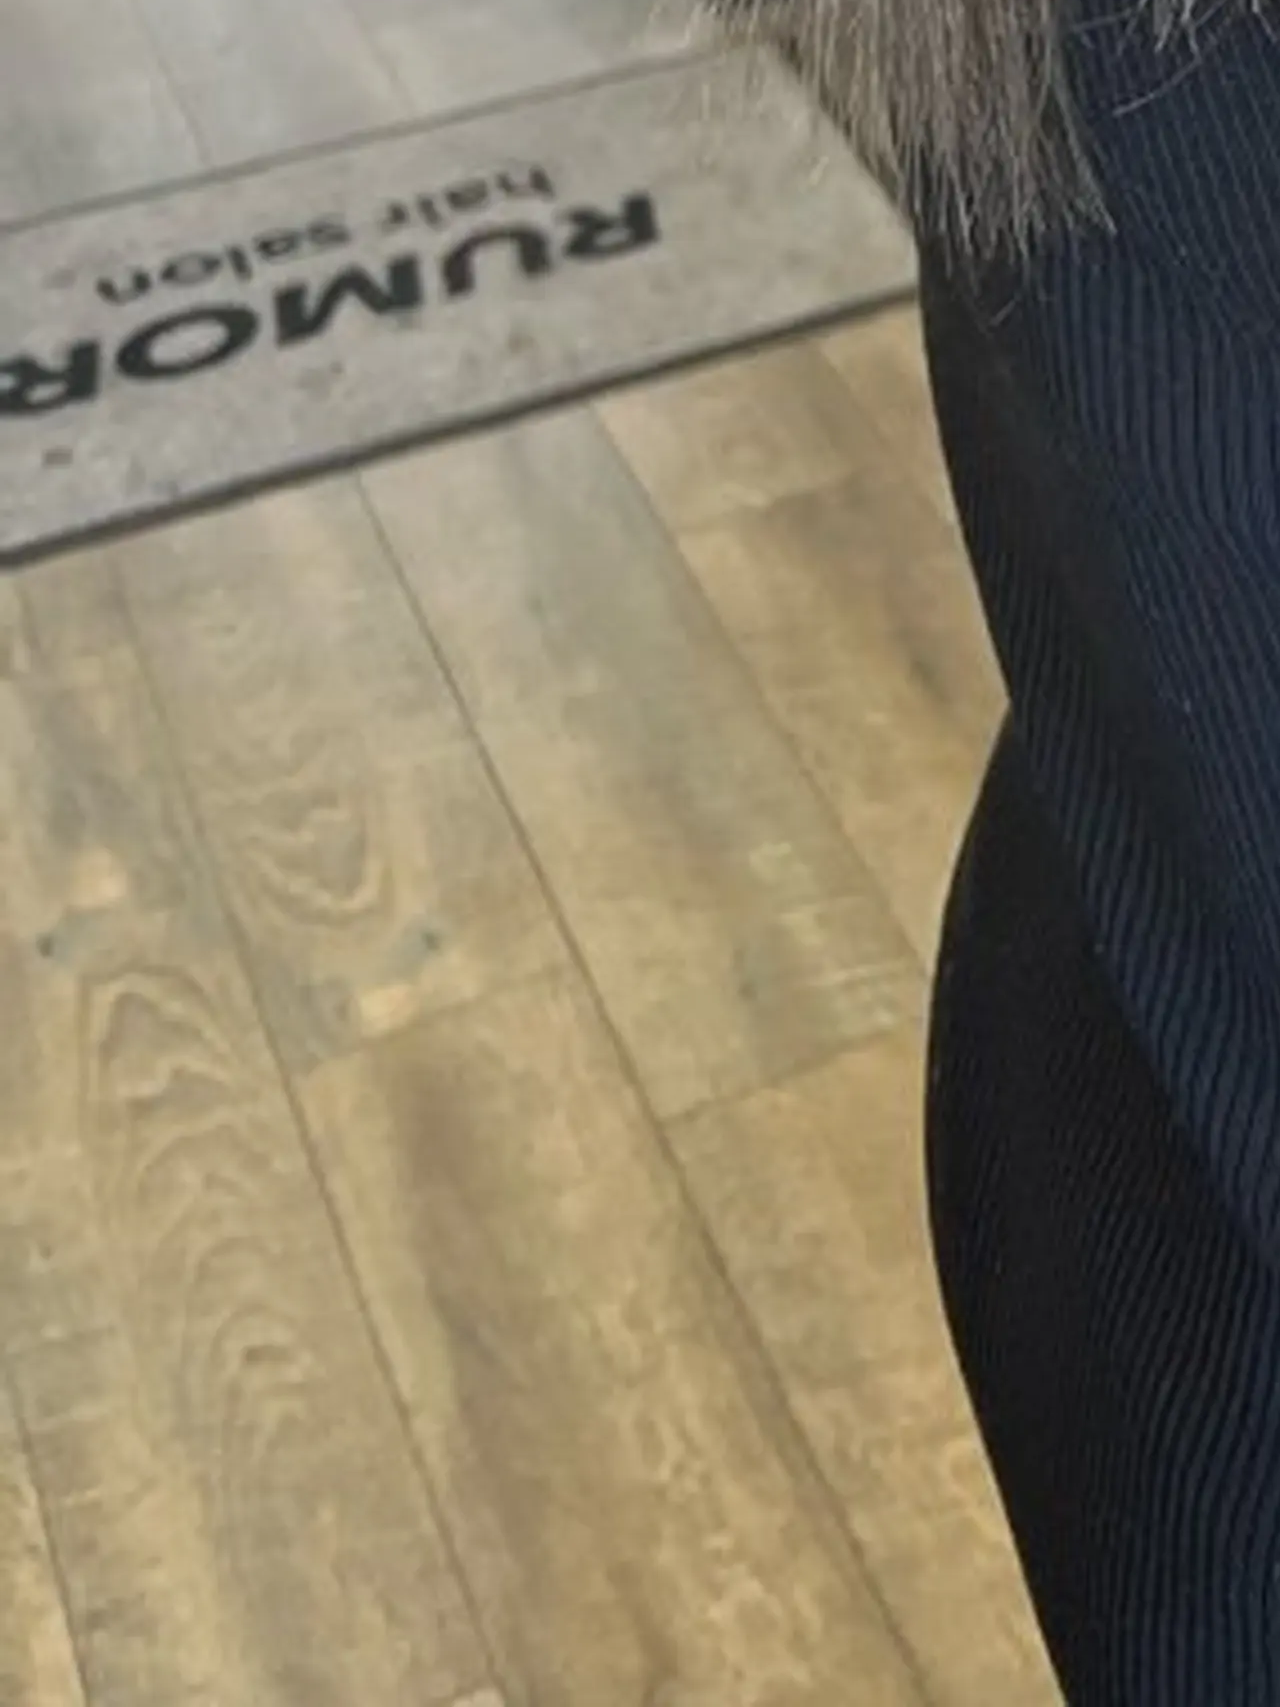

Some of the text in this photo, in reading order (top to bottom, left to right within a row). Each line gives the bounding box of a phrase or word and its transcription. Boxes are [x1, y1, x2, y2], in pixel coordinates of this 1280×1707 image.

[0, 192, 660, 416] RUMOR
[97, 165, 557, 306] hair salon
